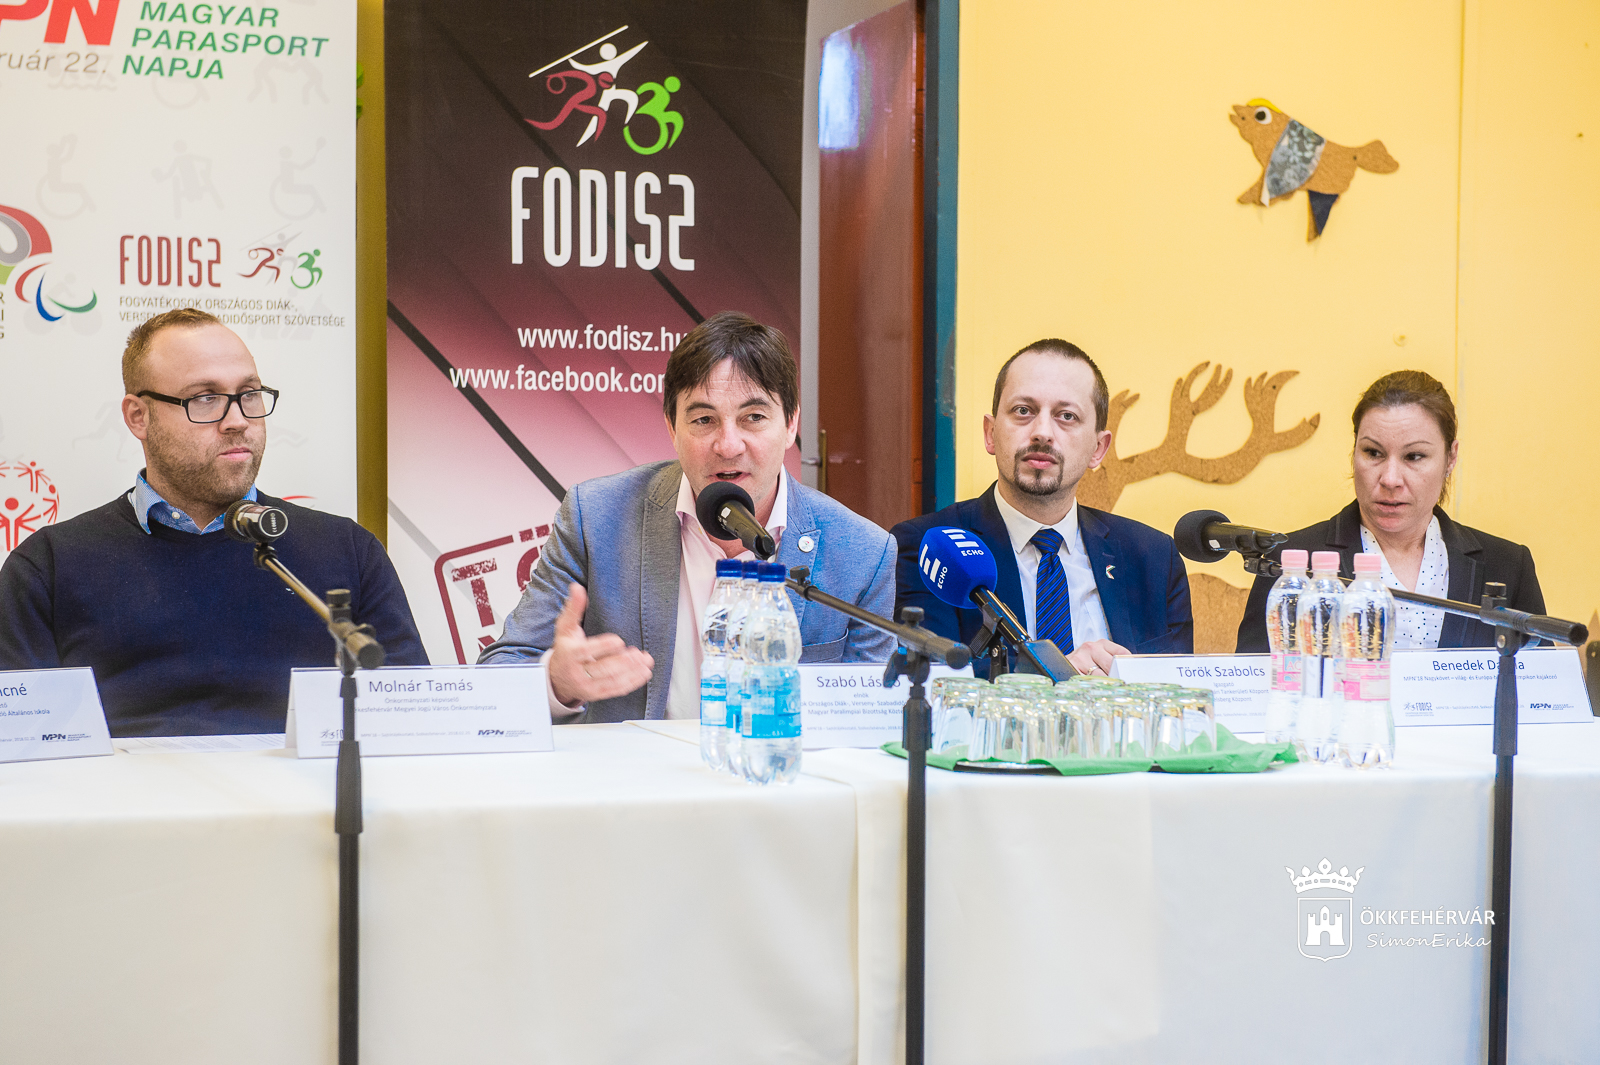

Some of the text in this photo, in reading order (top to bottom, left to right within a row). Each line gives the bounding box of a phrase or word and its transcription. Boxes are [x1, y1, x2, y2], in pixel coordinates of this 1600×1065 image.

[140, 1, 279, 28] MAGYAR
[131, 28, 329, 57] PARASPORT
[64, 51, 107, 73] 22.
[121, 55, 224, 80] NAPJA
[510, 166, 695, 272] FODISZ
[119, 234, 221, 288] FODISZ
[119, 295, 202, 309] FOGYATÉKOSOK
[205, 296, 263, 311] ORSZÁGOS
[284, 314, 345, 327] SZÖVETSÉGE
[960, 549, 984, 557] ECHO
[937, 566, 948, 589] ECHO
[1176, 665, 1266, 678] Török Szabolcs
[1432, 659, 1485, 671] Benedek
[369, 678, 473, 693] Molnár Tamás
[816, 675, 901, 688] Szabó Lás
[384, 696, 459, 705] Önkormányzati képviselő
[450, 704, 497, 712] Önkormányzata
[42, 733, 66, 741] MPN
